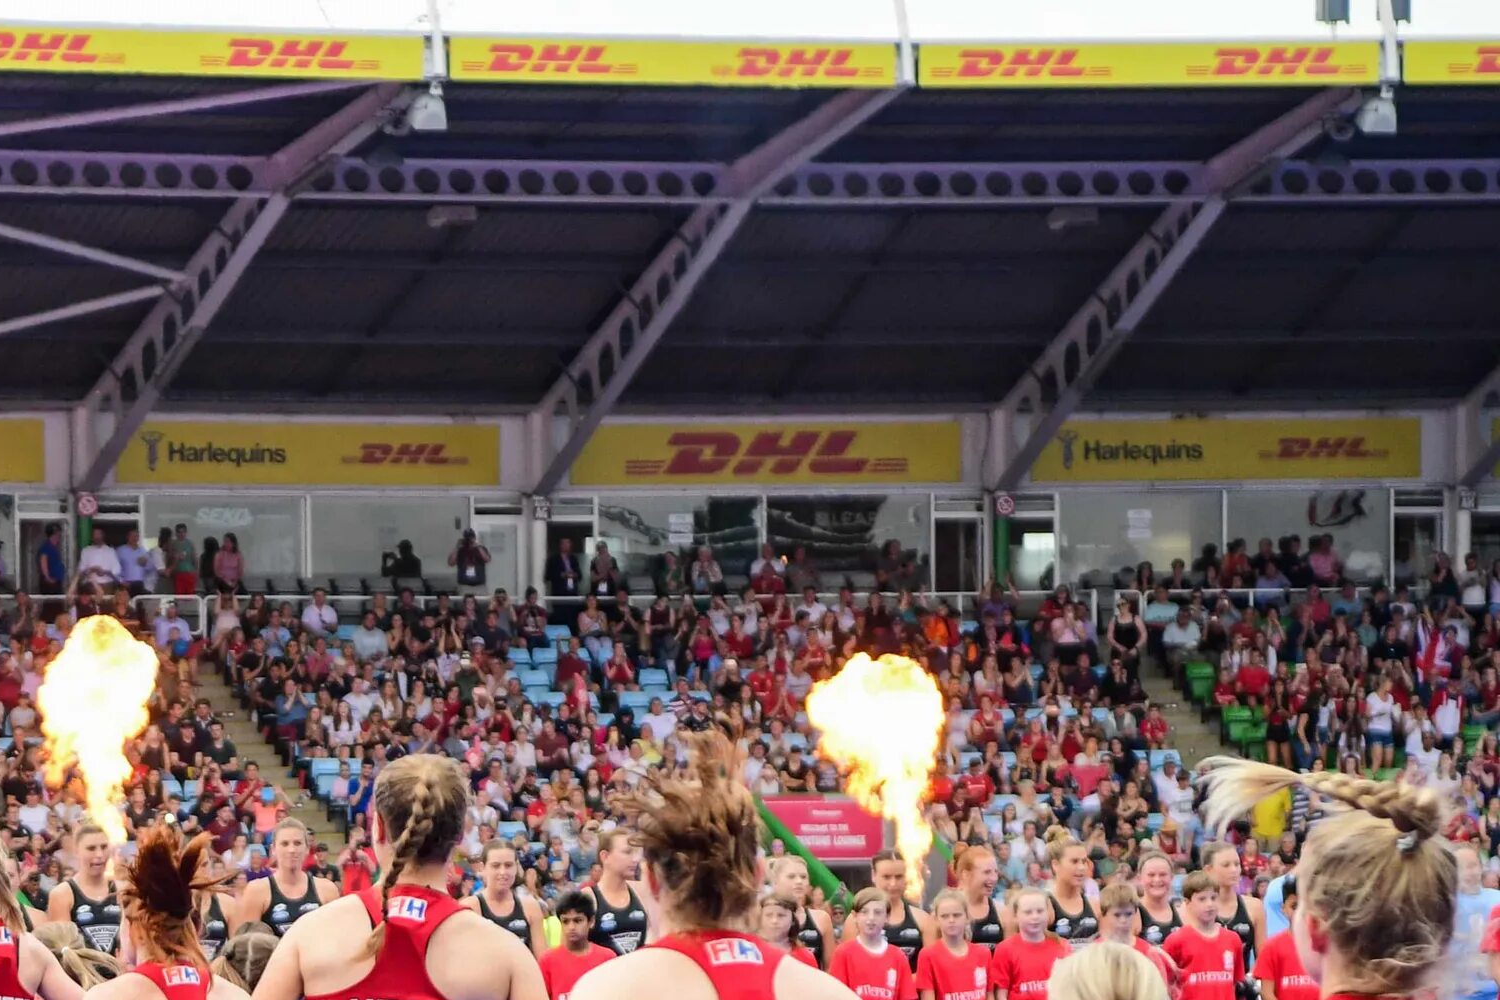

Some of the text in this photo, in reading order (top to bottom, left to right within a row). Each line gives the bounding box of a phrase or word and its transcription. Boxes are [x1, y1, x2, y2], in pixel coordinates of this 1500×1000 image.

[226, 37, 358, 71] DHL
[487, 43, 616, 75] DHL
[736, 48, 859, 79] DHL
[957, 49, 1086, 79] DHL
[1214, 47, 1344, 77] DHL
[167, 442, 286, 466] Harlequins
[360, 443, 450, 464] DHL
[665, 431, 869, 476] DHL
[1083, 438, 1203, 463] Harlequins
[1277, 437, 1368, 459] DHL
